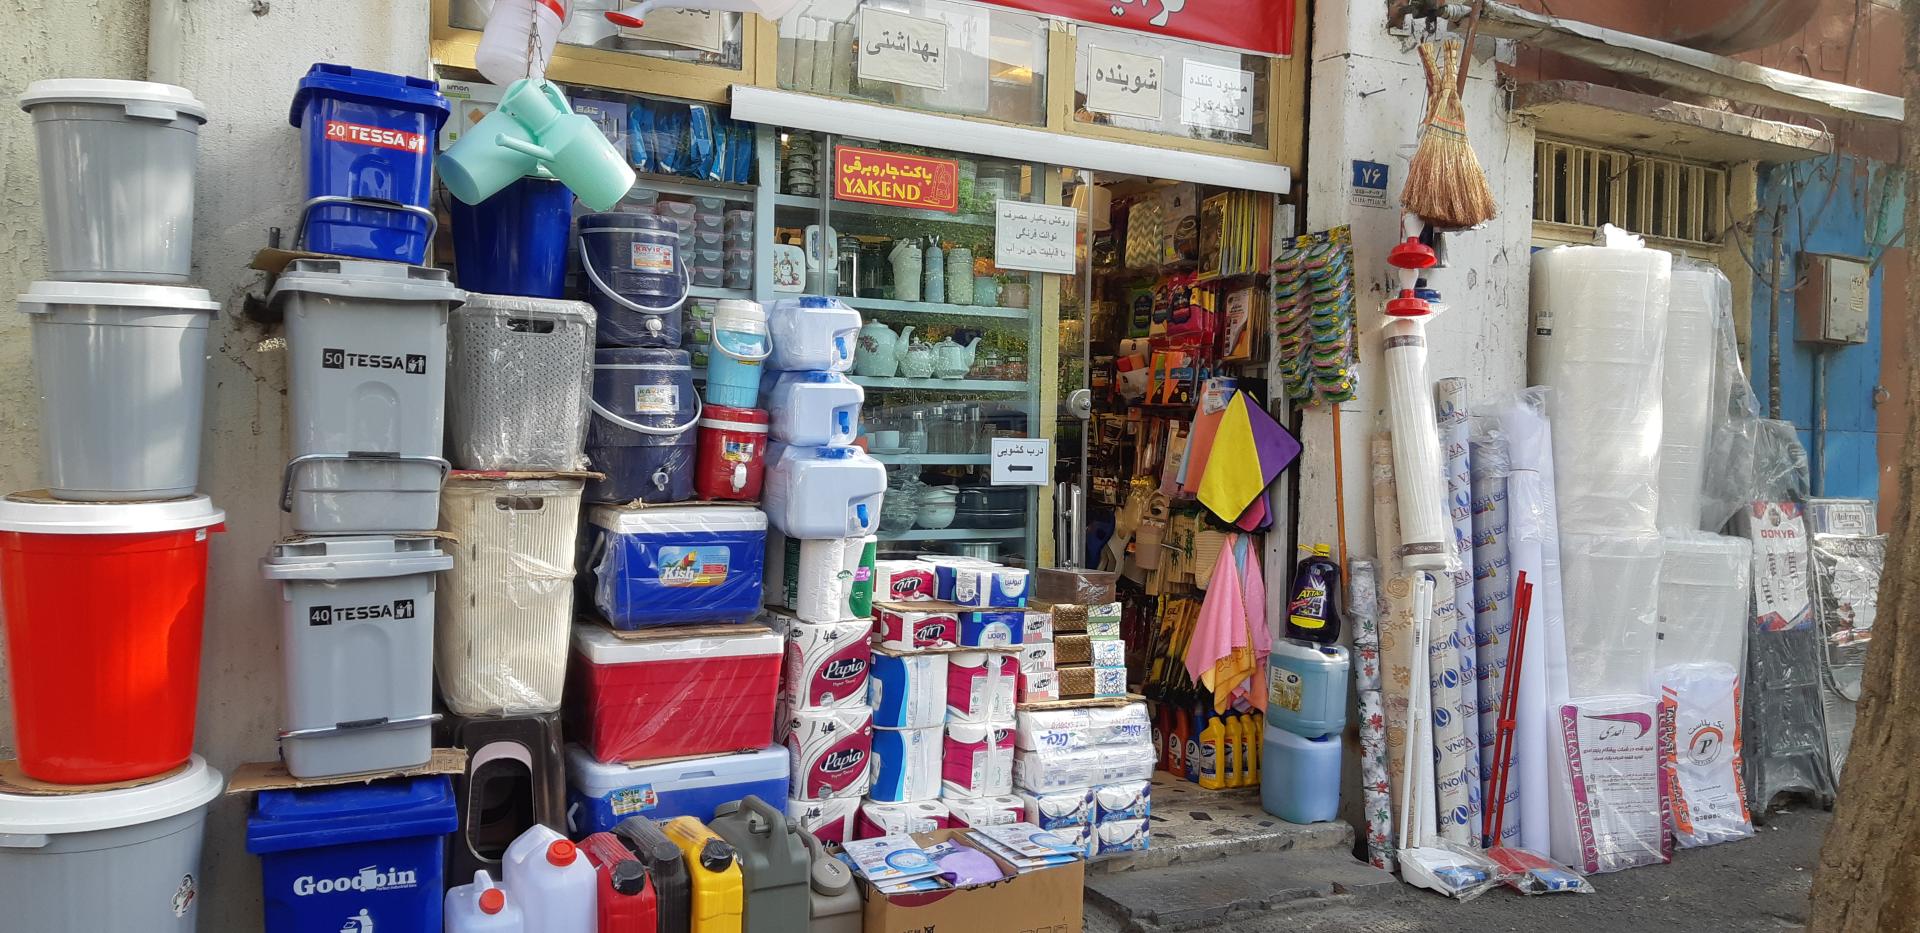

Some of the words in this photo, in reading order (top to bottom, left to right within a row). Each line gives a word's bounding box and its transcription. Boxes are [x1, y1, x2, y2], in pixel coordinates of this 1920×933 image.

[866, 30, 939, 62] بهداشتی
[1096, 65, 1158, 93] شوینده
[1189, 74, 1213, 87] کننده
[327, 124, 345, 137] 20
[349, 126, 406, 147] TESSA
[900, 165, 932, 186] پاکت
[1362, 168, 1381, 185] ۷۶
[843, 177, 921, 200] YAKEND
[1003, 210, 1028, 220] مصرف
[1049, 216, 1070, 227] روکش
[1026, 246, 1037, 256] حل
[1039, 248, 1058, 259] قابلیت
[325, 353, 342, 365] 50
[346, 353, 404, 370] TESSA
[997, 444, 1024, 458] کشویی
[1027, 447, 1044, 457] درب
[663, 565, 694, 580] Kish
[312, 610, 330, 622] 40
[334, 605, 393, 621] TESSA
[825, 658, 863, 679] Papia
[1563, 716, 1582, 777] AHADI
[824, 748, 861, 771] Papia
[1578, 802, 1598, 865] AHADI
